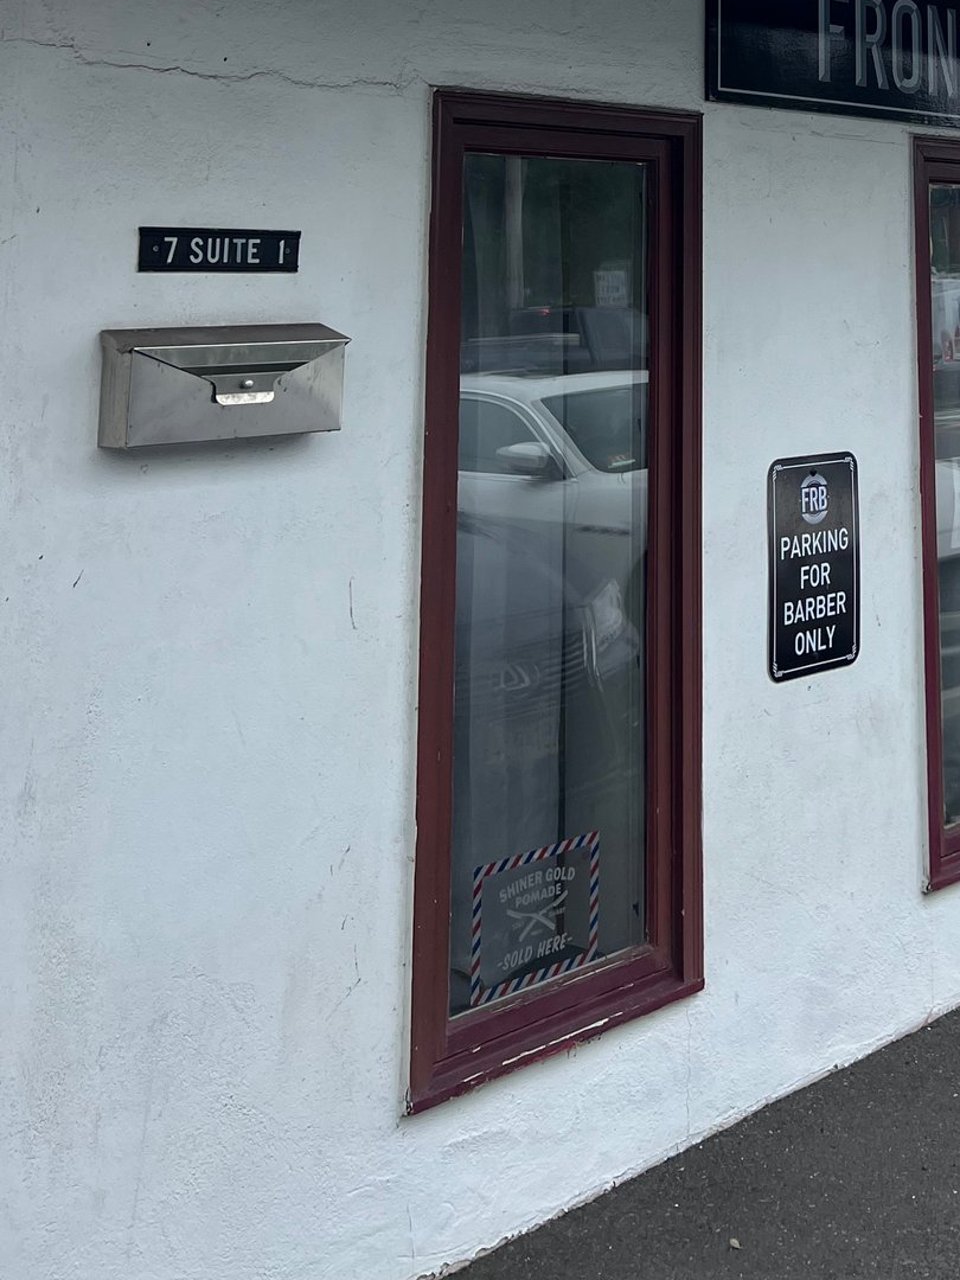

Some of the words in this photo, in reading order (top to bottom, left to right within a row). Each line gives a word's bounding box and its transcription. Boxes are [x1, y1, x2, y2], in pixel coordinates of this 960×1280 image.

[164, 237, 178, 263] 7
[190, 237, 261, 263] SUITE
[279, 240, 286, 264] 1
[801, 486, 828, 512] FRB
[781, 528, 848, 560] PARKING
[800, 562, 831, 589] FOR
[784, 591, 846, 625] BARBER
[795, 625, 836, 656] ONLY
[499, 870, 543, 903] SHINER
[545, 867, 576, 882] GOLD
[515, 883, 562, 909] POMADE
